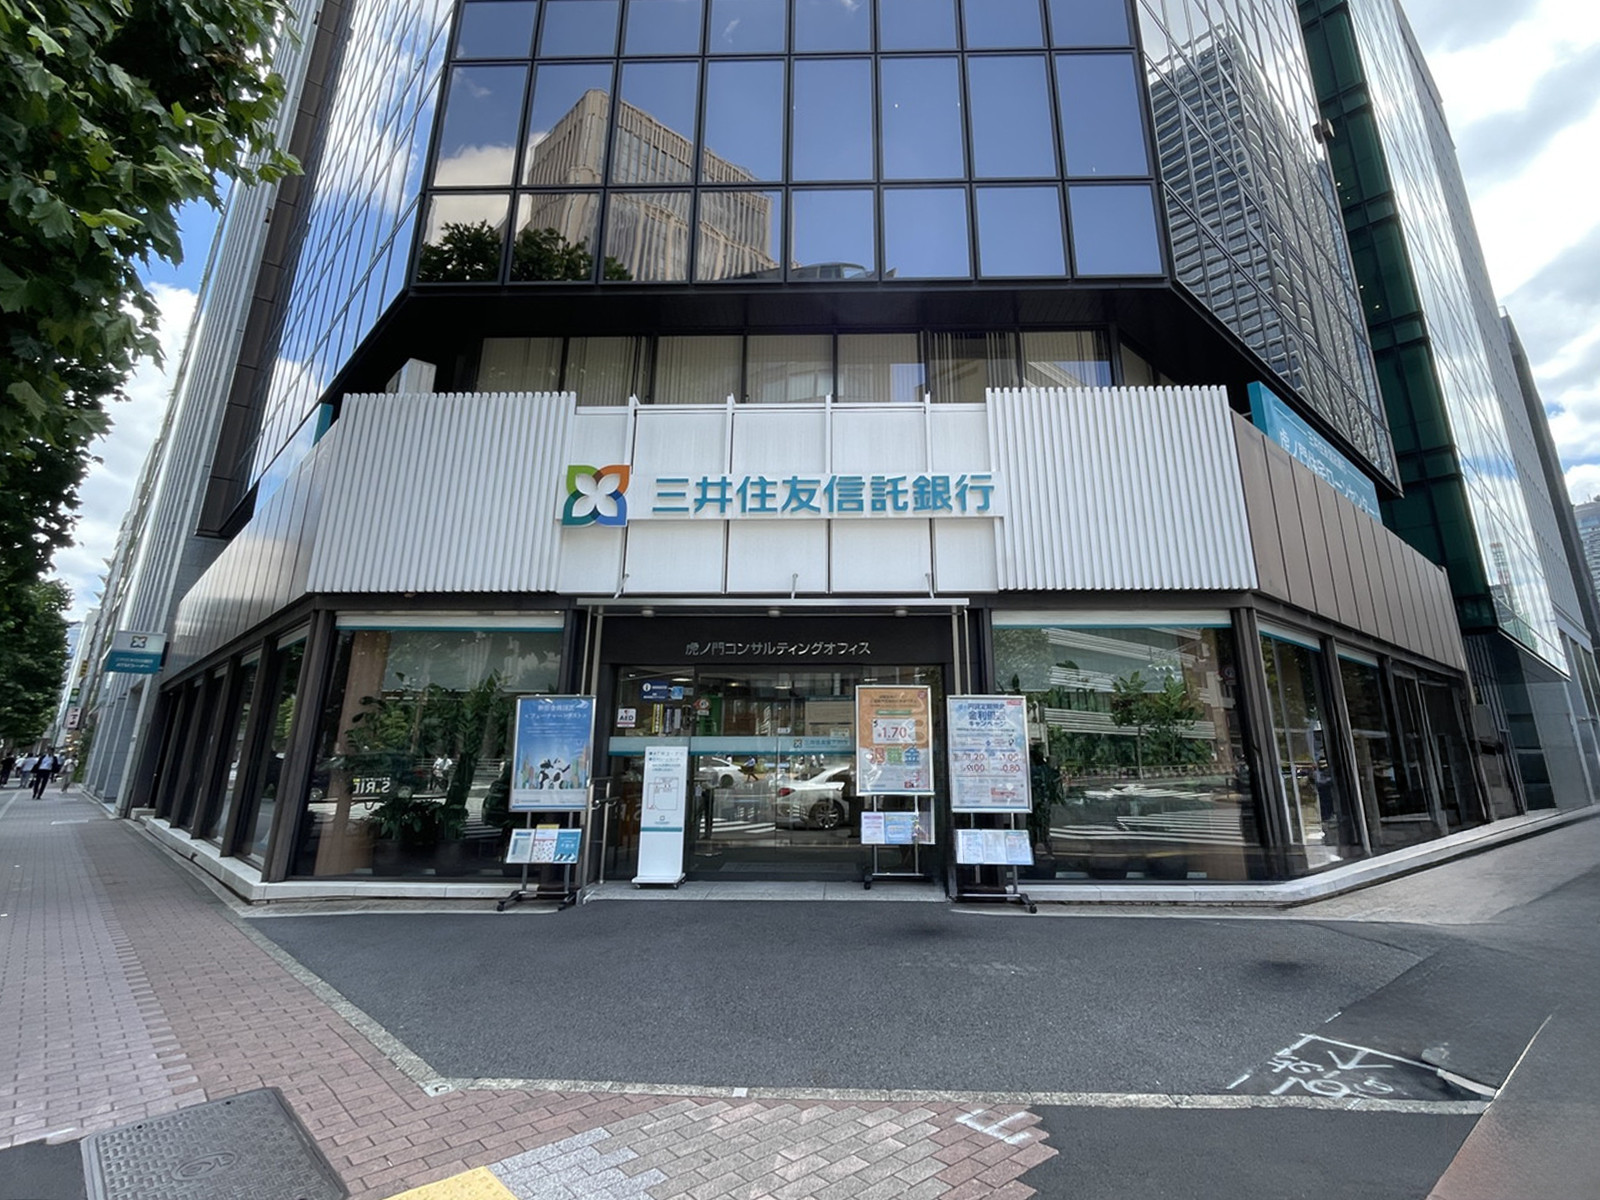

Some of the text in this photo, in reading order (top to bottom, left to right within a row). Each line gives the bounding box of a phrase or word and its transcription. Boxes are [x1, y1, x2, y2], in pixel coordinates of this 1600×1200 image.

[652, 474, 995, 514] 三井住友信託銀行
[685, 641, 871, 656] 虎ノ門コンサルティングオフィス
[882, 727, 907, 738] 1.70
